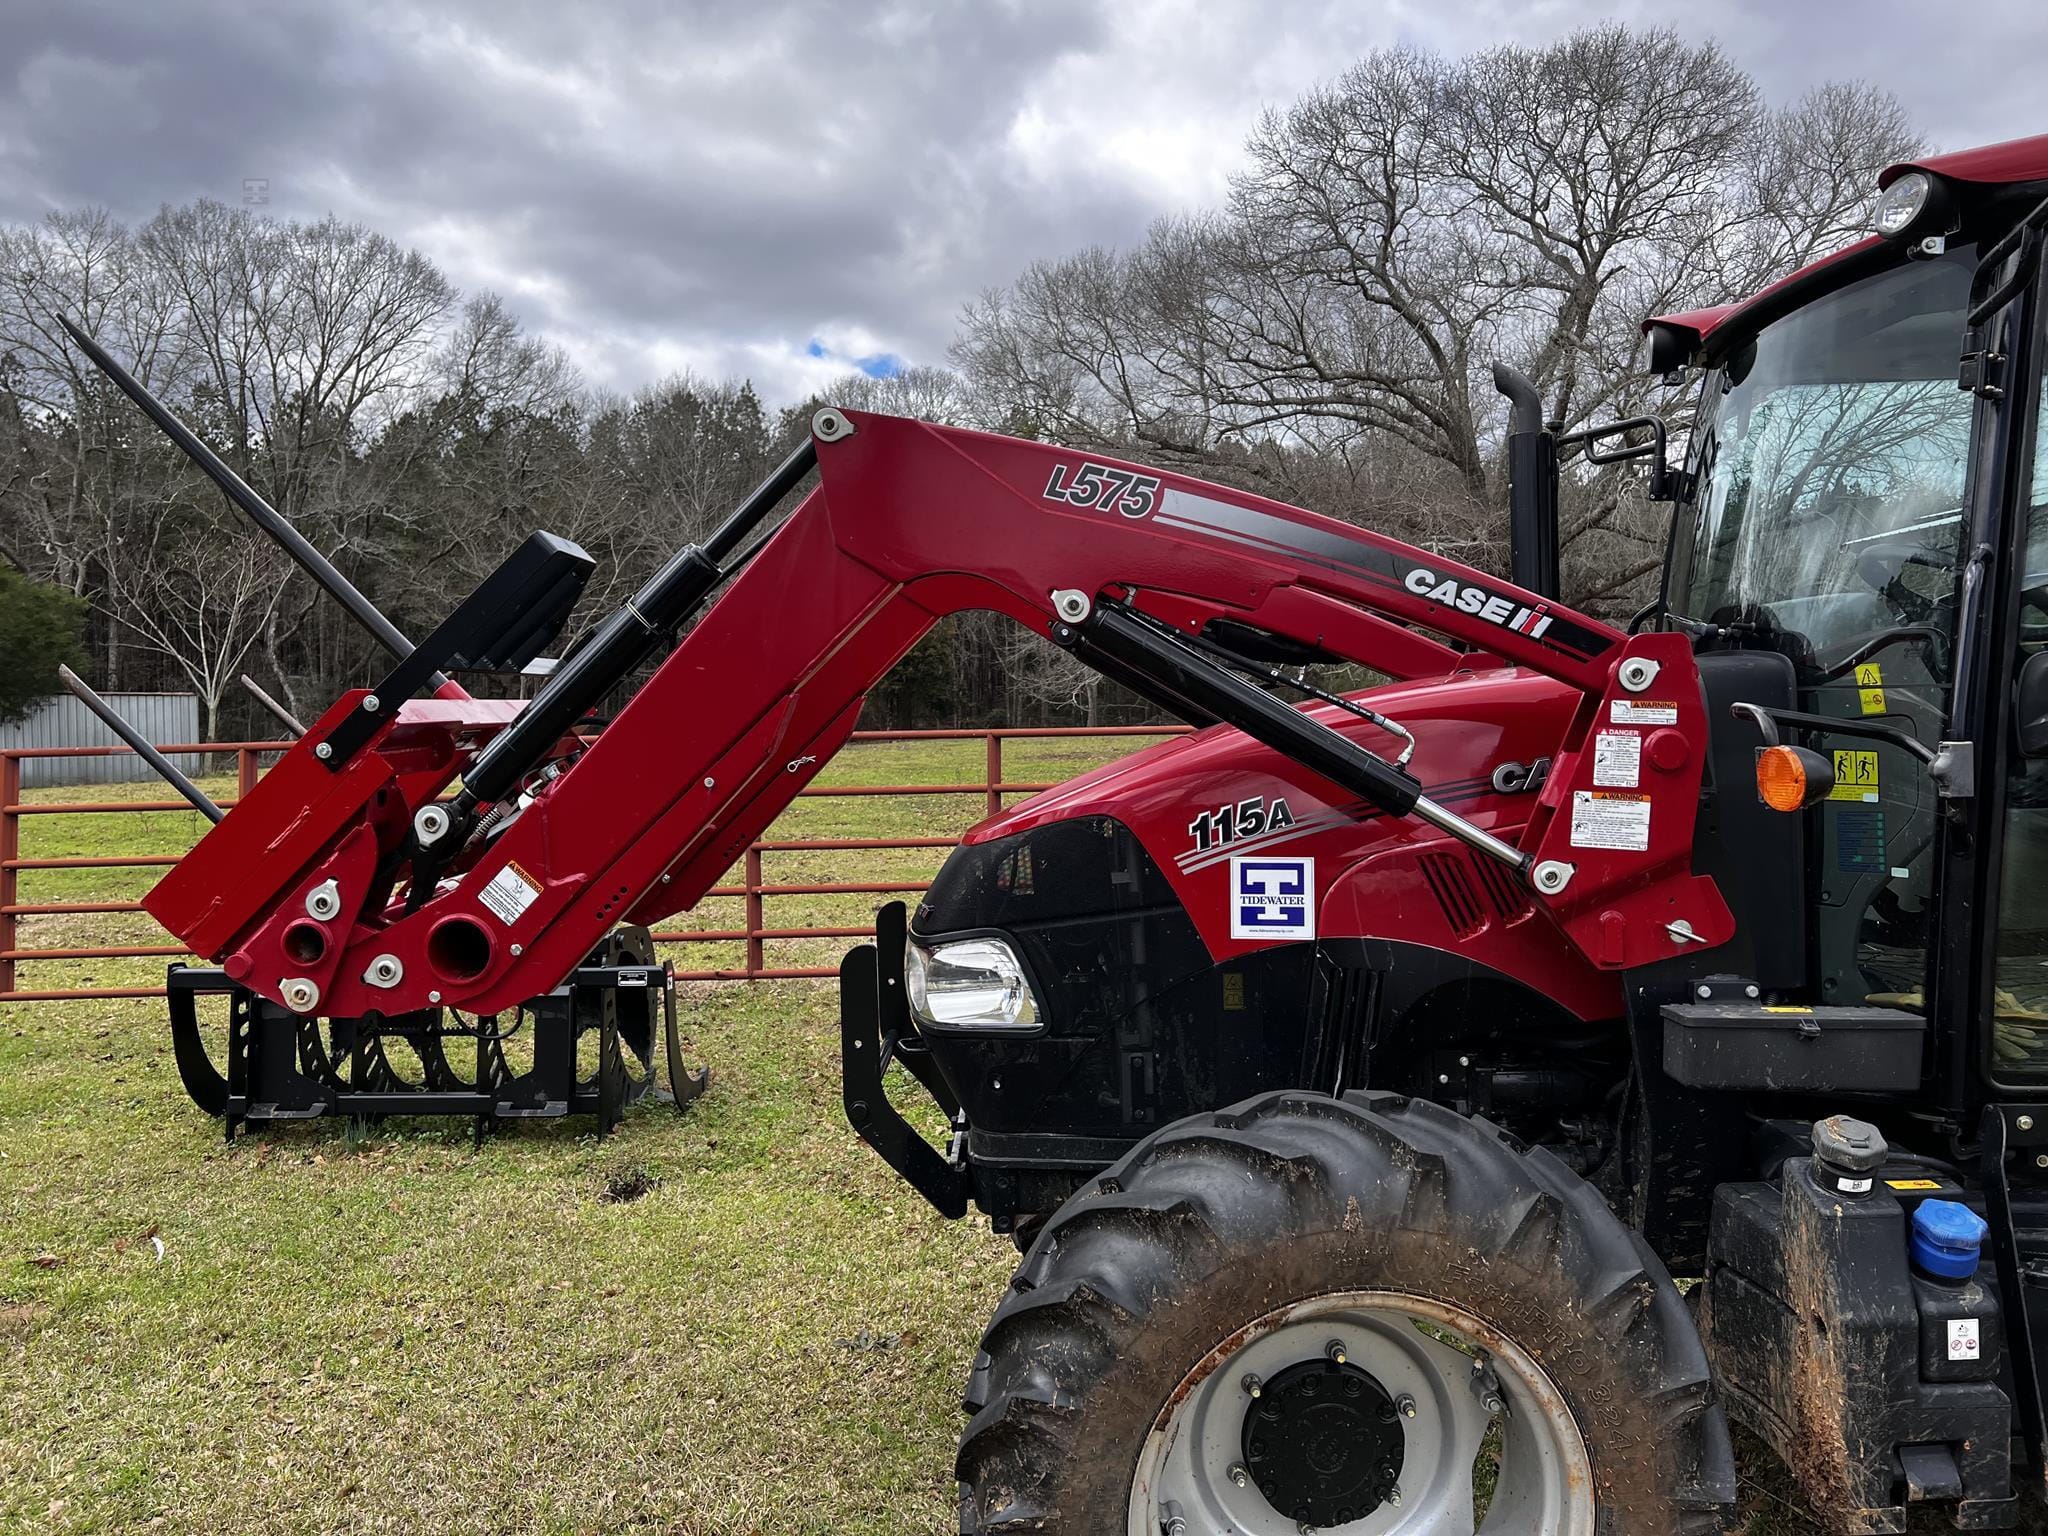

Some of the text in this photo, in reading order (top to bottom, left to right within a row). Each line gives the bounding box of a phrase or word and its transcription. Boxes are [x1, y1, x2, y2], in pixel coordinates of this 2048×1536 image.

[1043, 462, 1161, 519] L575
[1405, 569, 1515, 624] CASE
[1640, 701, 1676, 709] WARNING
[1609, 729, 1640, 737] DANGER
[1609, 792, 1644, 801] WARNING
[1189, 796, 1295, 852] 115A
[513, 864, 543, 893] WARNING
[1239, 895, 1305, 905] TIDEWATER
[1441, 1262, 1633, 1452] FarmPRO 324
